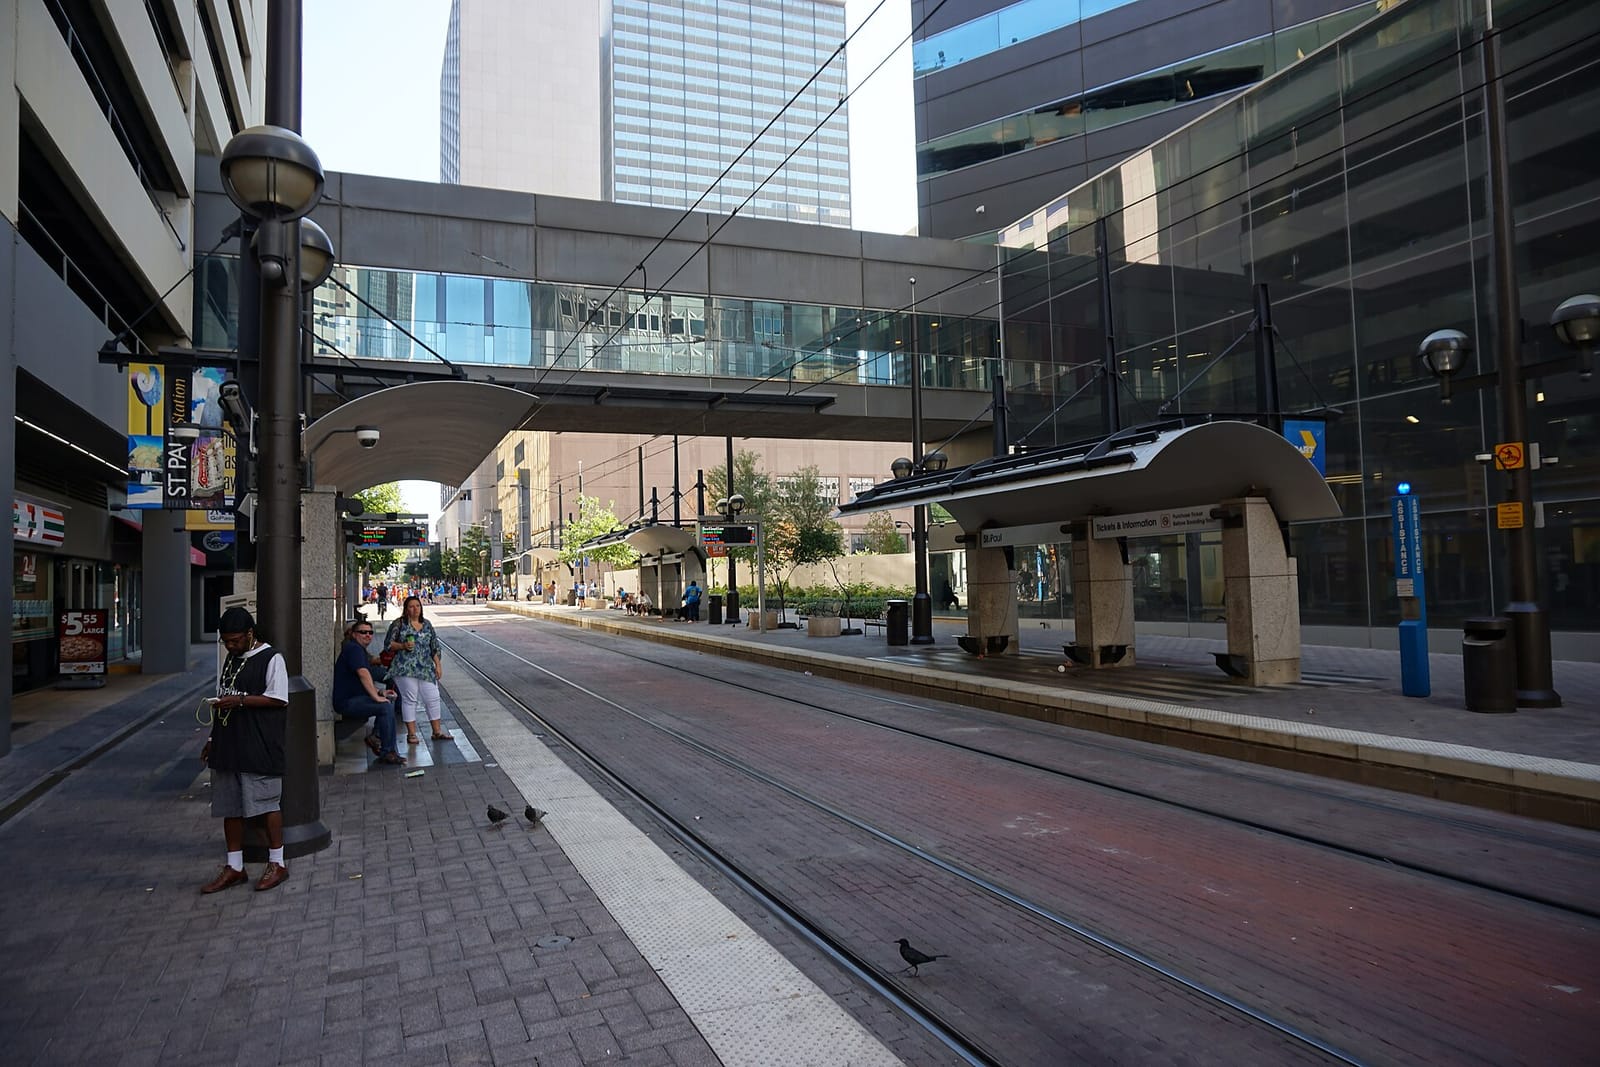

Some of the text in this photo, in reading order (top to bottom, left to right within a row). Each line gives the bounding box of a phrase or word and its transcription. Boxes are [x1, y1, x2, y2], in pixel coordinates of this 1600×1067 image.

[172, 378, 187, 424] Station
[167, 428, 187, 497] ST PA
[1096, 523, 1116, 533] Tickets
[1123, 518, 1157, 529] Information
[1397, 499, 1409, 575] ASSISTANCE
[1412, 498, 1422, 574] ASSISTANCE
